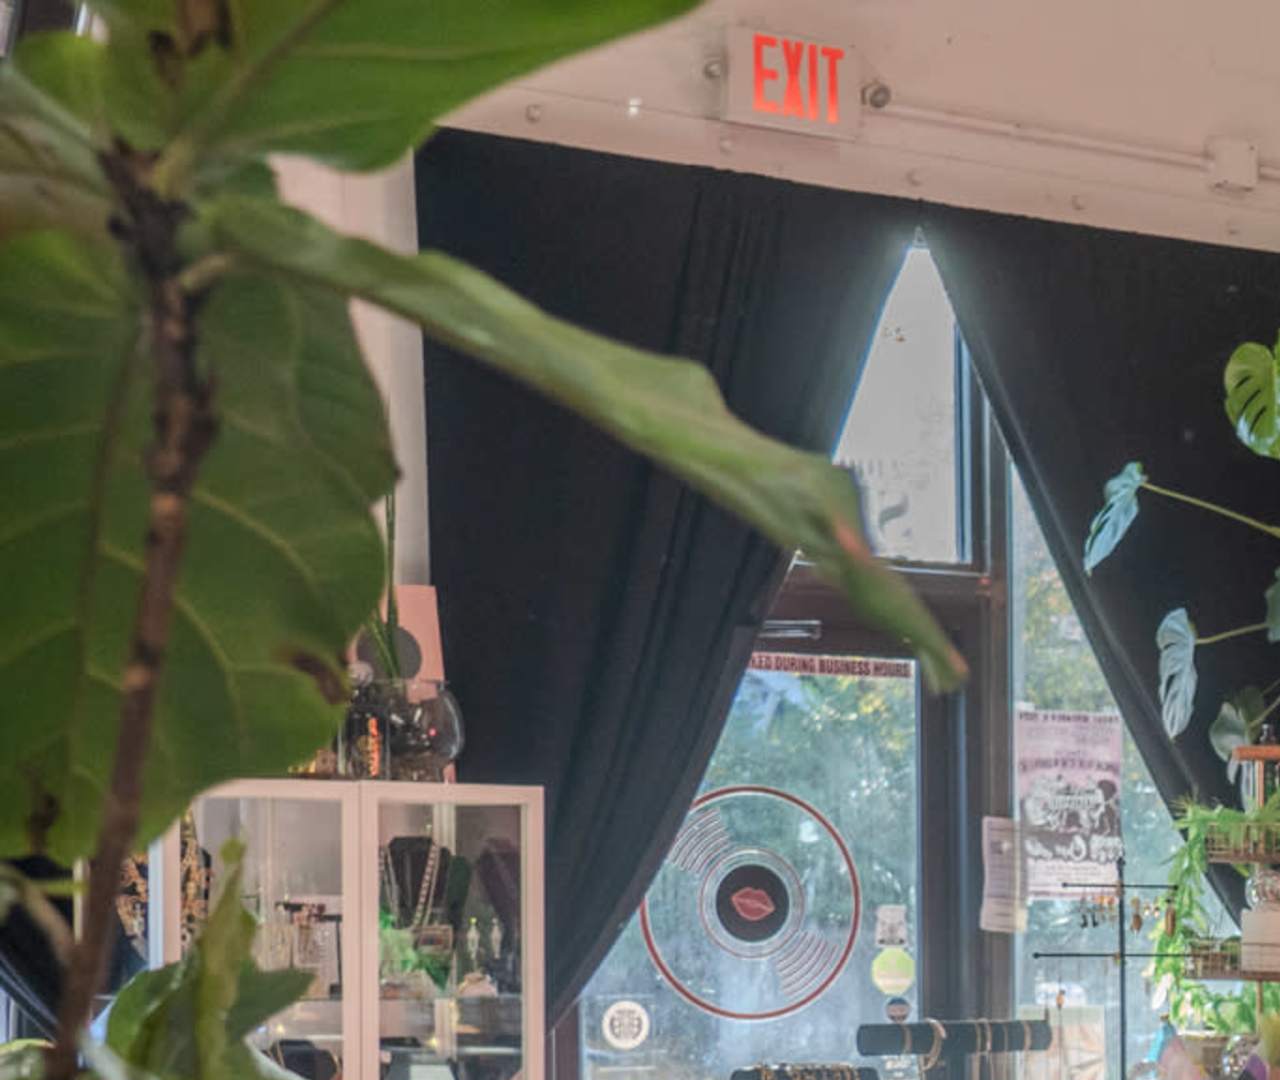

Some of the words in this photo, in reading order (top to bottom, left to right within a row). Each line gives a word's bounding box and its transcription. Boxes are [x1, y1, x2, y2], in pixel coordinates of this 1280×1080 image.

[753, 33, 846, 124] EXIT
[774, 655, 816, 673] DURING
[818, 658, 871, 676] BUSINESS
[873, 661, 911, 678] HOURS
